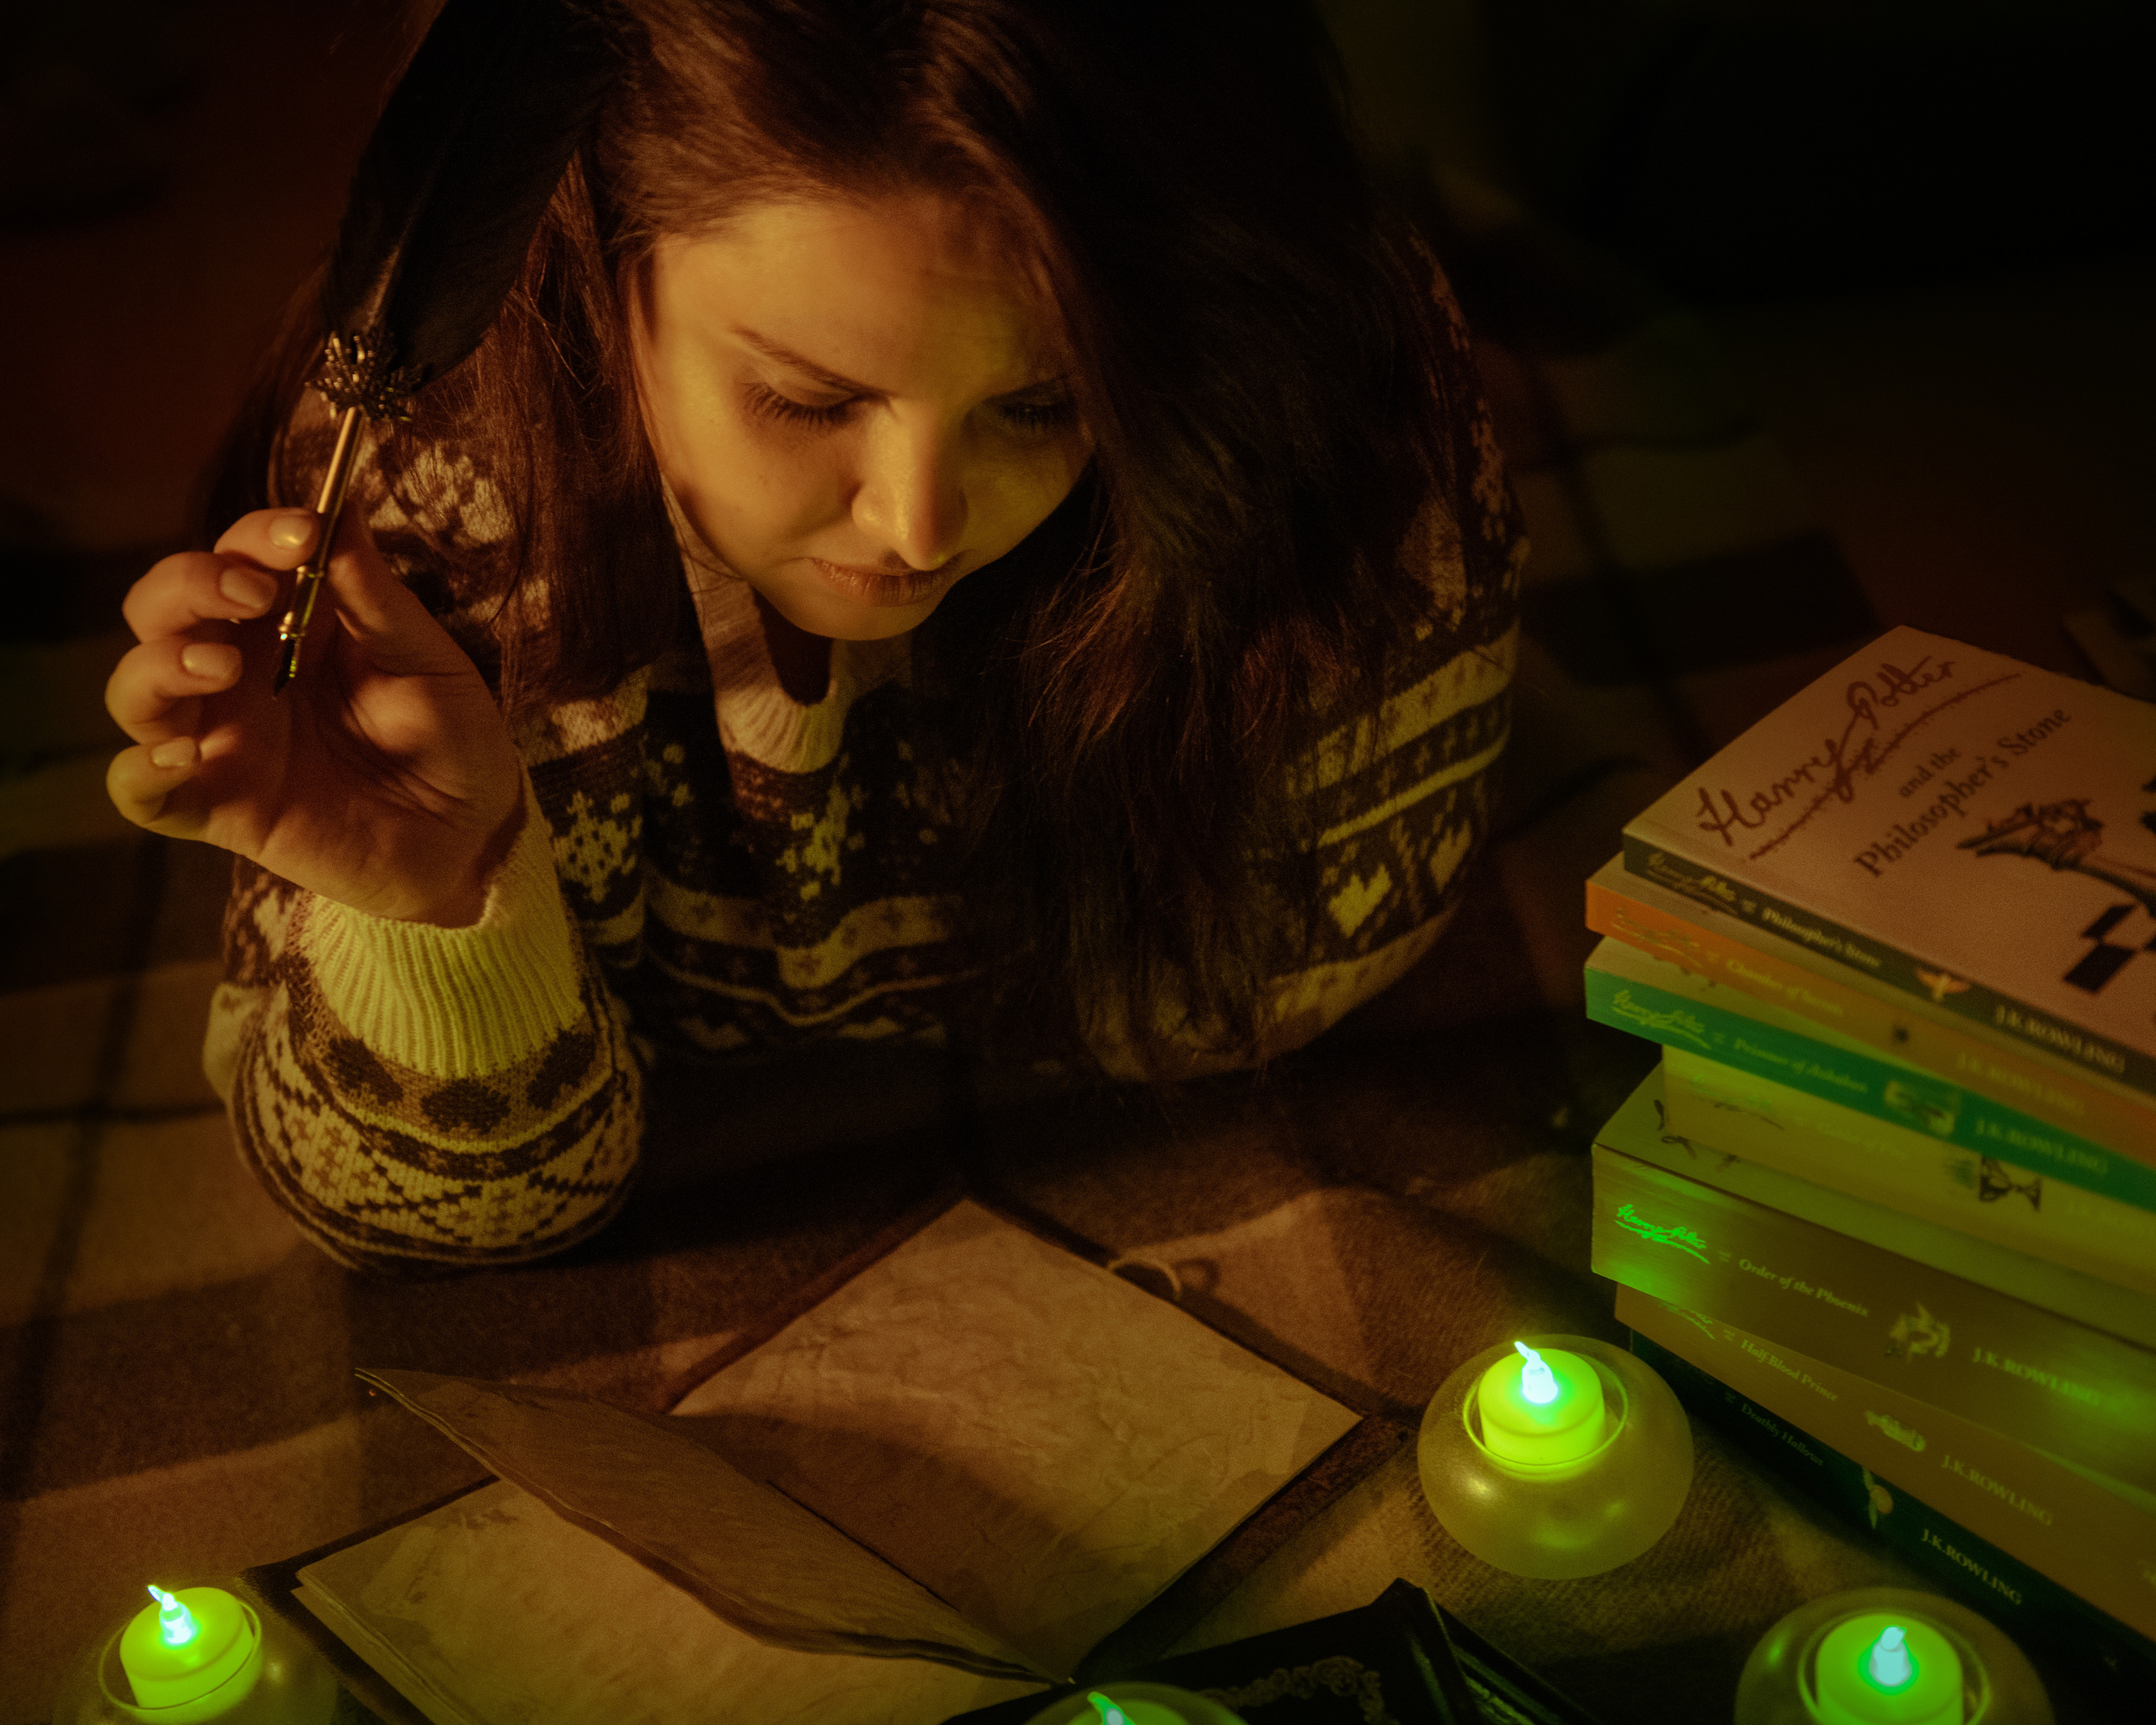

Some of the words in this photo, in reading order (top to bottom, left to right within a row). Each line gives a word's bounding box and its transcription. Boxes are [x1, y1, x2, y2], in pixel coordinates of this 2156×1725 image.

[1694, 738, 1855, 847] Harry
[1846, 654, 1957, 732] Potter
[1899, 765, 1935, 798] and
[1929, 748, 1962, 771] the
[1854, 756, 2010, 878] Philosopher's
[1997, 708, 2072, 756] Stone
[1738, 1258, 1778, 1280] Order
[1778, 1276, 1795, 1290] of
[1793, 1280, 1814, 1295] the
[1801, 1374, 1838, 1402] Prince
